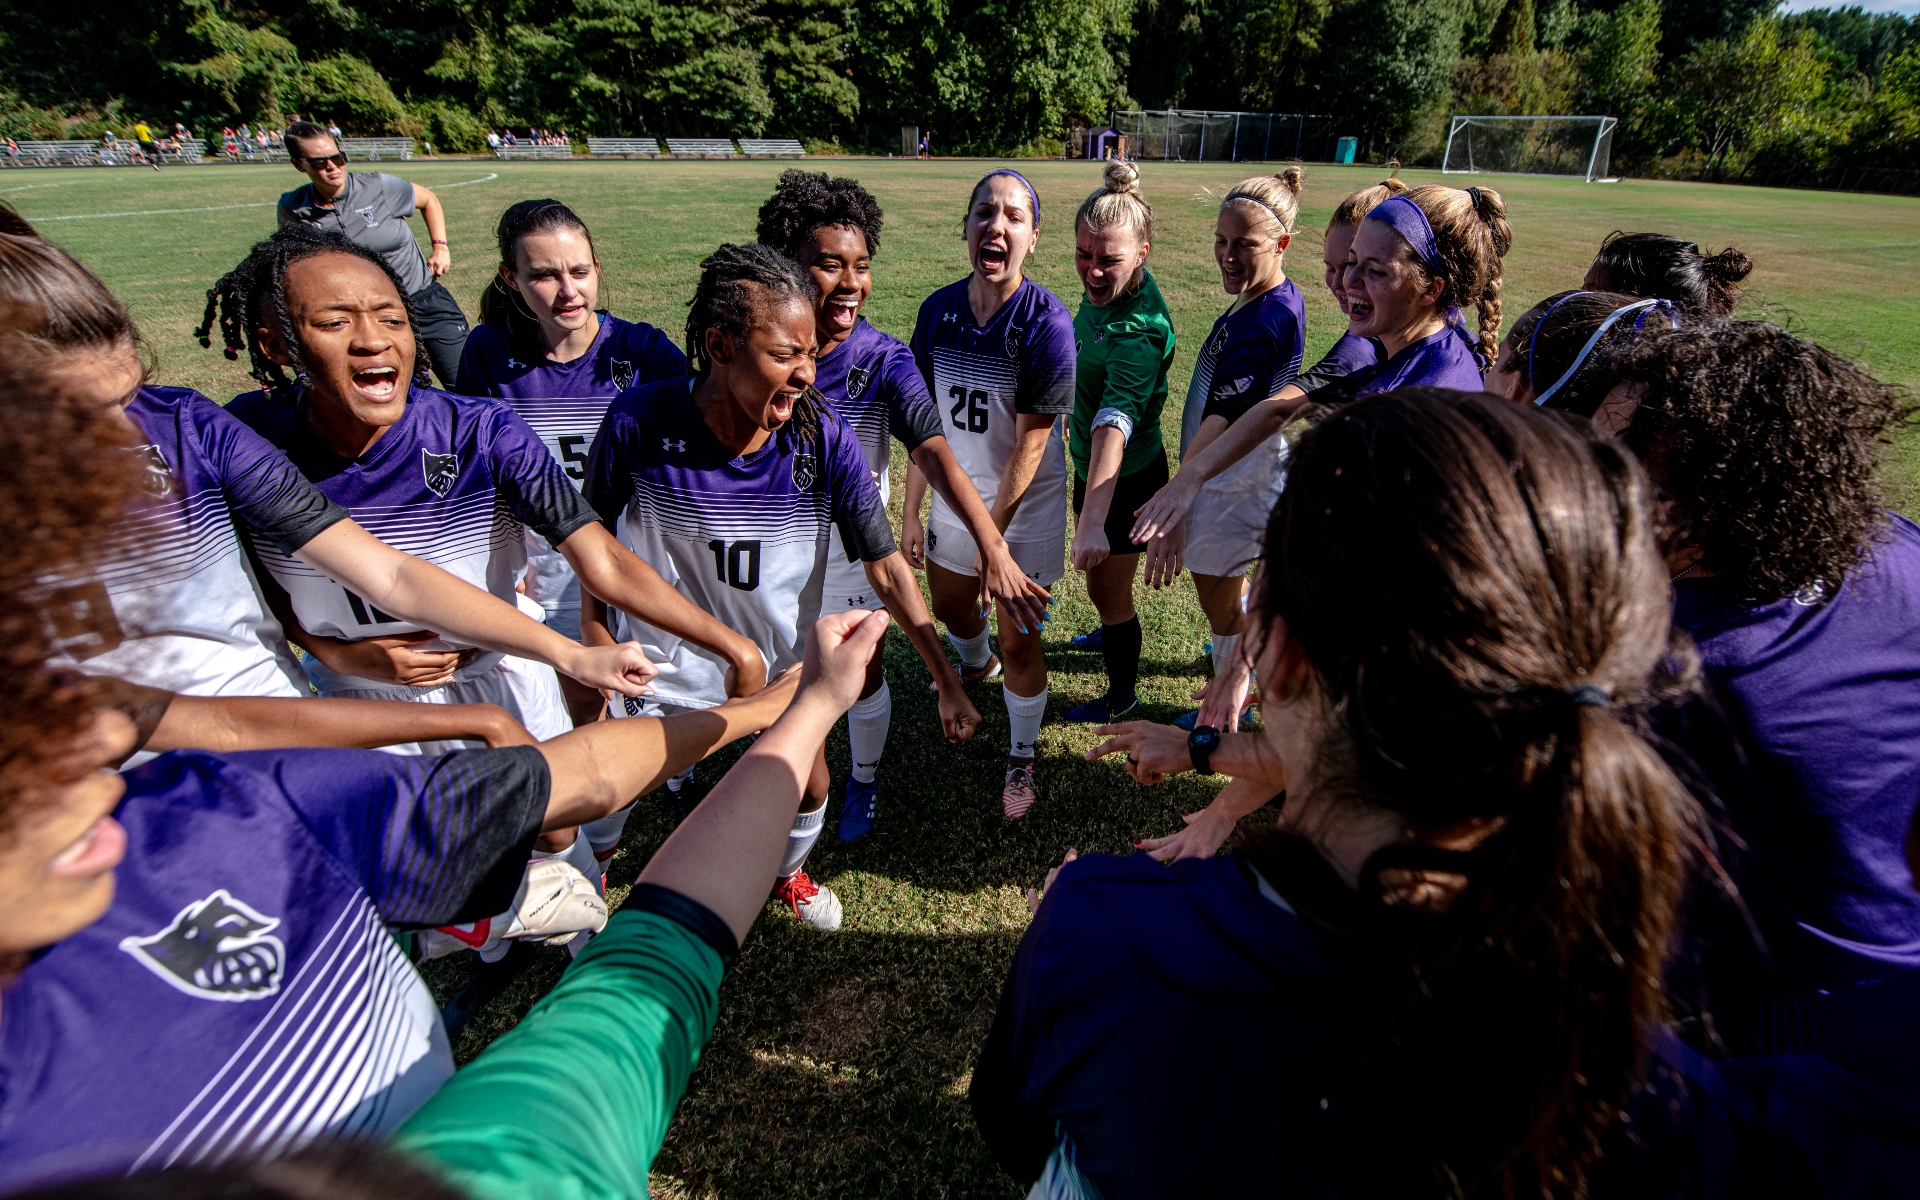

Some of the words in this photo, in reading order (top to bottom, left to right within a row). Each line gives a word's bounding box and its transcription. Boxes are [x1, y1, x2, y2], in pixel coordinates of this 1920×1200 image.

[949, 385, 989, 434] 26
[558, 436, 589, 480] 5
[708, 539, 761, 592] 10
[329, 577, 403, 625] 1
